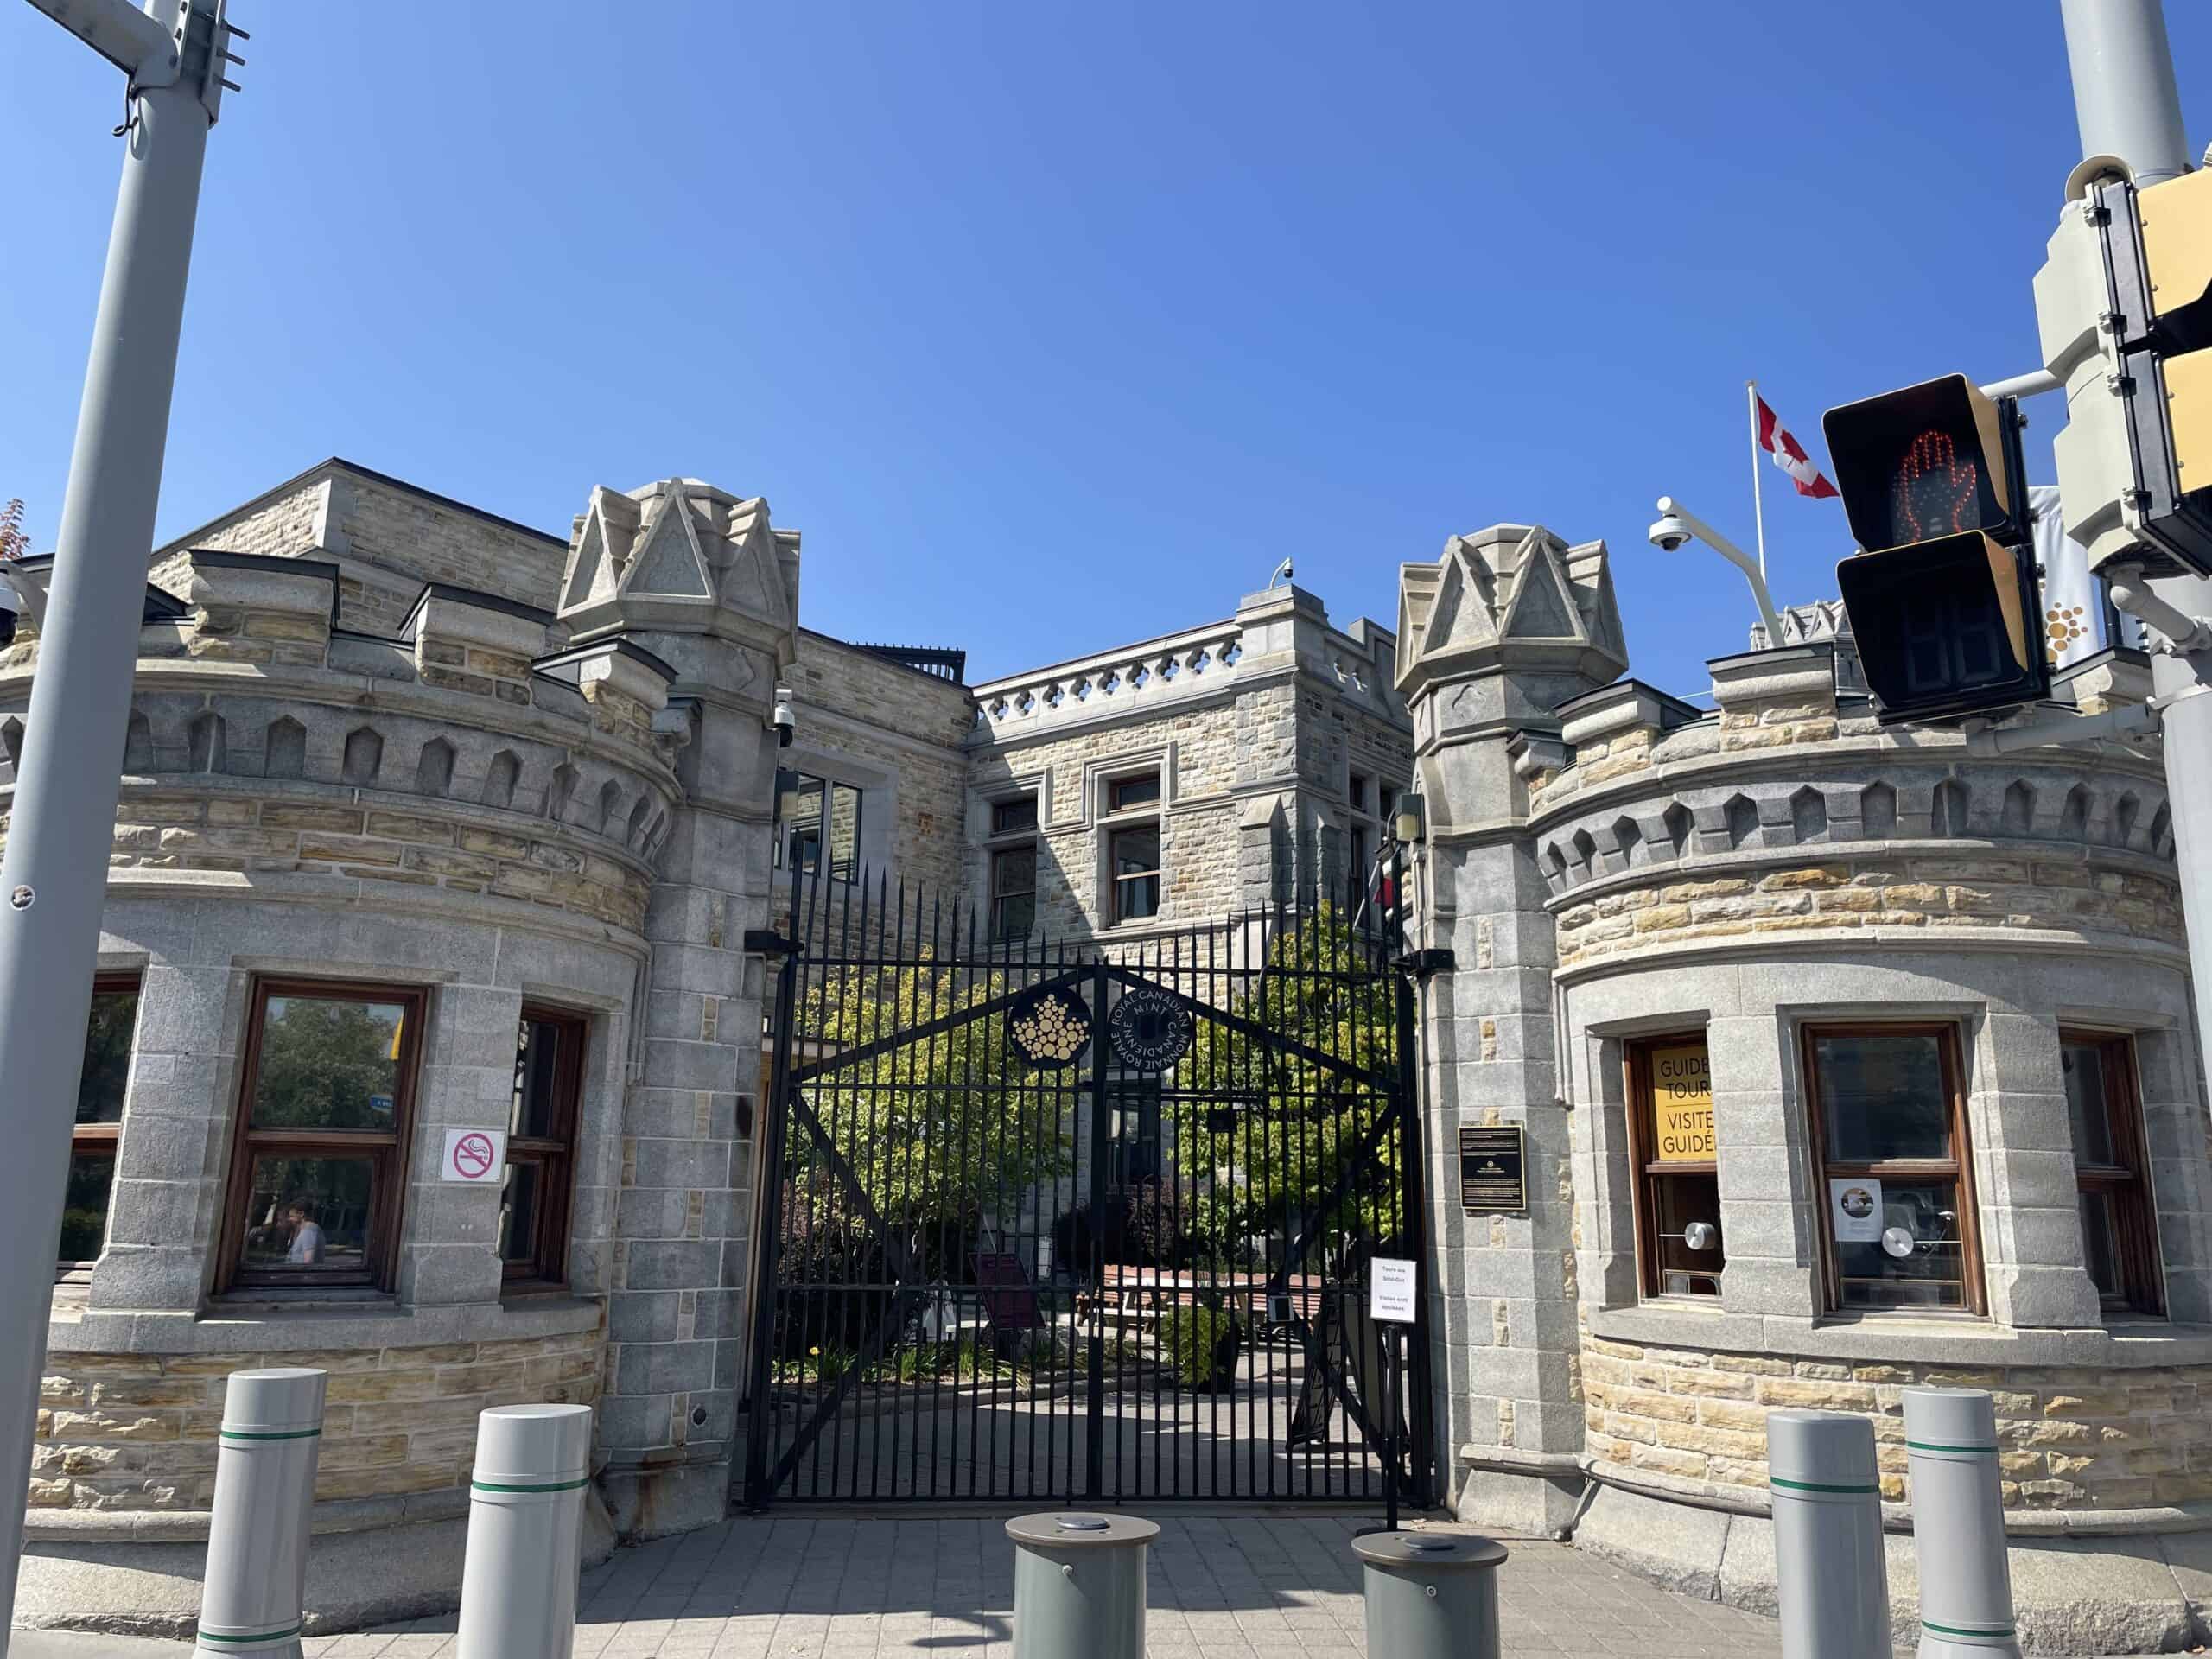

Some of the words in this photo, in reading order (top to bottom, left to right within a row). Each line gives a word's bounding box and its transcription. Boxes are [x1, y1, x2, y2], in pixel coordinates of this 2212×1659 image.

[1111, 995, 1138, 1026] ROYAL
[1138, 990, 1189, 1027] CANADIAN
[1133, 1002, 1167, 1015] MINT
[1111, 1031, 1141, 1068] ROYALE
[1123, 1021, 1177, 1058] CANADIENNE
[1145, 1033, 1189, 1070] MONNAIE
[1660, 1057, 1710, 1077] GUIDE
[1666, 1079, 1713, 1100] TOUR
[1667, 1111, 1714, 1129] VISITE
[1663, 1129, 1717, 1154] GUIDÉ
